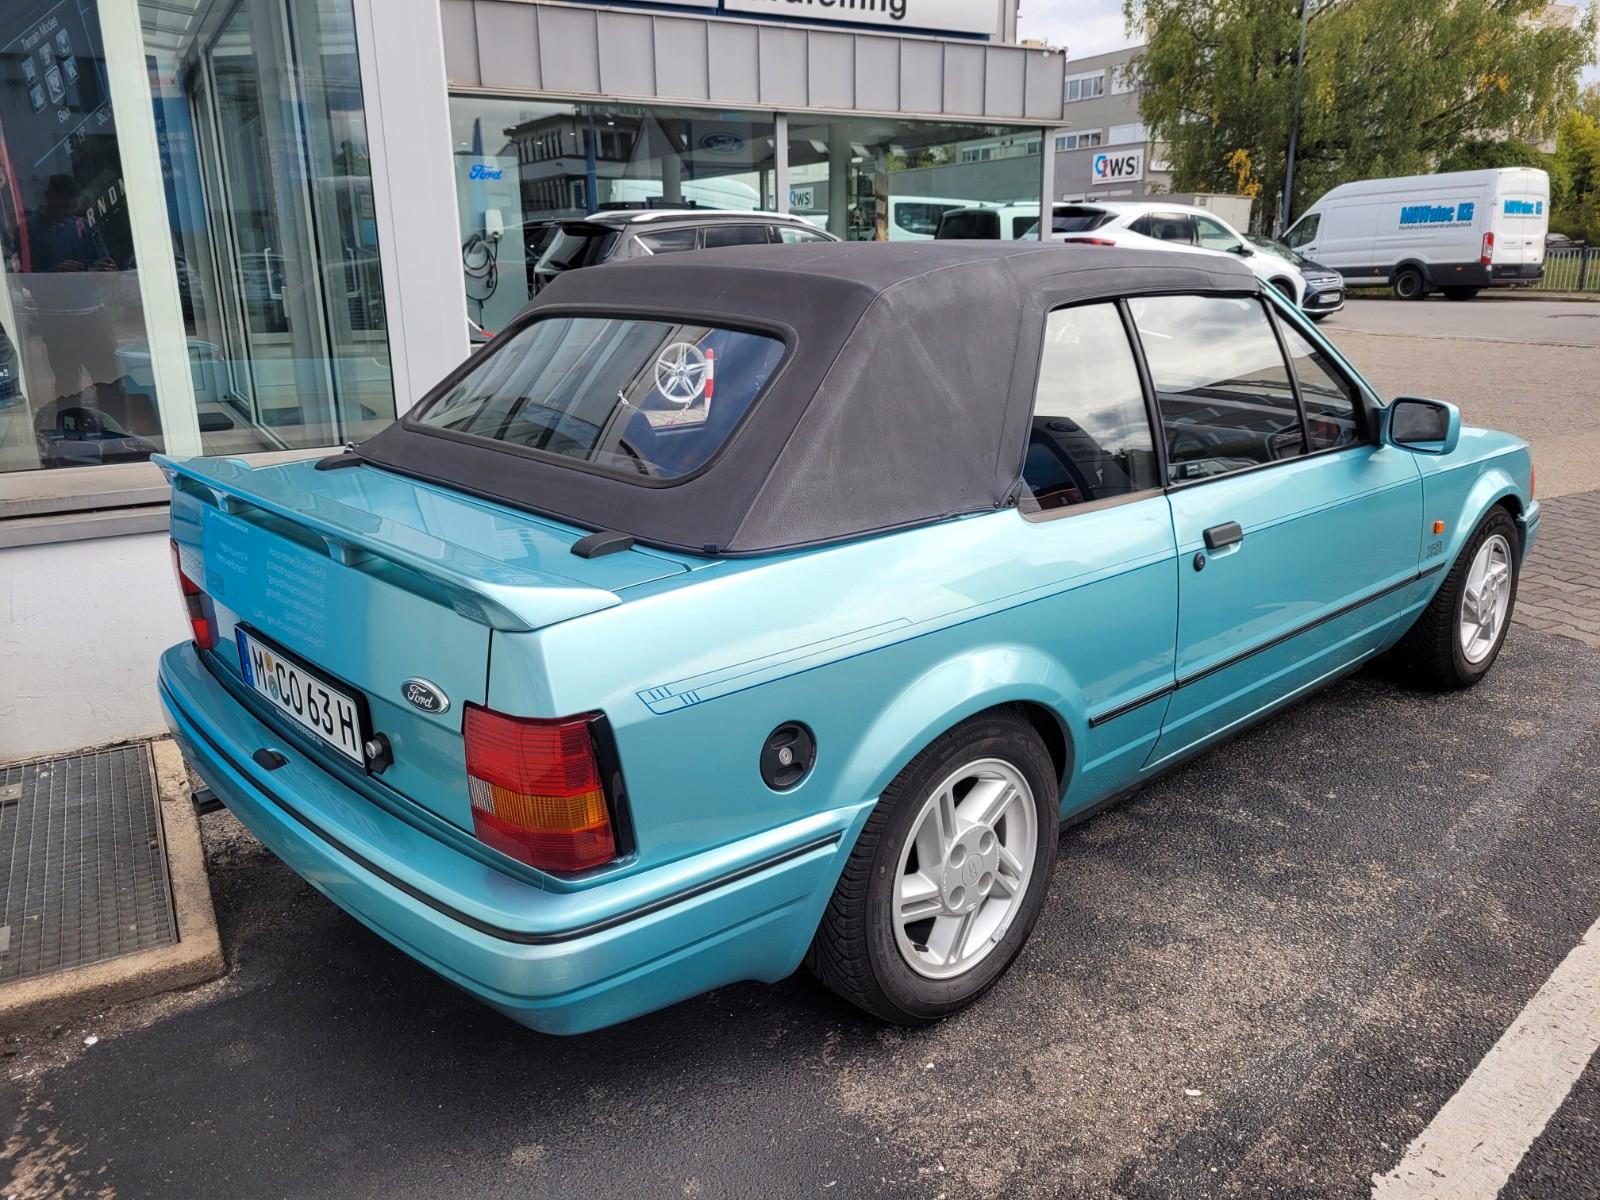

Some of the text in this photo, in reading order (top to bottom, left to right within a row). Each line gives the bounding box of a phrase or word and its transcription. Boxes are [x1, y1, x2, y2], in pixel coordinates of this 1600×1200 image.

[469, 164, 503, 180] Ford
[86, 207, 96, 228] R
[97, 196, 107, 217] N
[108, 185, 118, 206] D
[251, 645, 268, 691] M
[275, 661, 303, 716] CO
[407, 684, 433, 709] Ford
